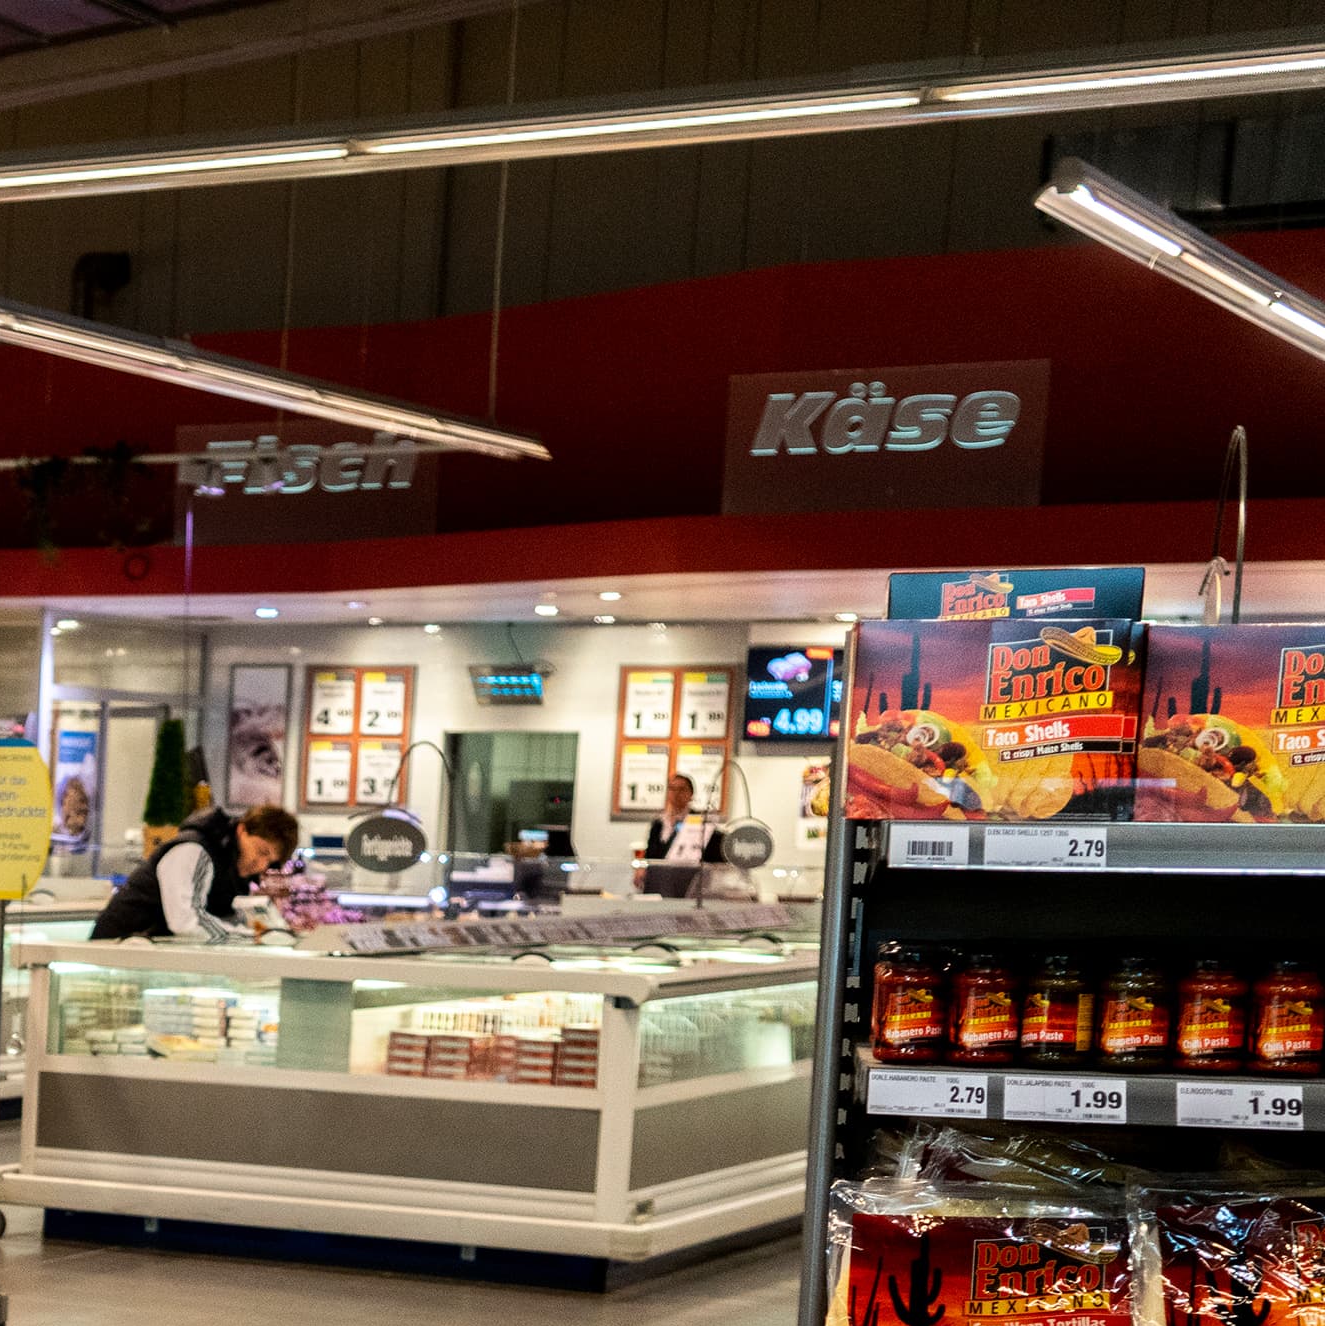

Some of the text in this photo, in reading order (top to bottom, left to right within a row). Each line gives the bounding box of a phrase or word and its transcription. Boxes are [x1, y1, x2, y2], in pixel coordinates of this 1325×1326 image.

[750, 381, 1022, 456] Käse
[204, 433, 418, 496] Fisch
[944, 583, 977, 598] Don
[944, 592, 1006, 614] Enrico
[993, 645, 1050, 671] Don
[990, 664, 1106, 703] Enrico
[984, 693, 1108, 719] MEXICANO
[773, 708, 824, 734] 4.99
[986, 721, 1070, 747] Taco Shells
[1278, 733, 1310, 750] Taco
[1003, 741, 1084, 760] 12 crispy Shells
[1069, 840, 1104, 858] 2.79
[886, 1027, 924, 1038] Habanero
[963, 1030, 1002, 1042] Habanero
[1040, 1031, 1064, 1041] Paste
[1205, 1037, 1230, 1047] Paste
[1286, 1040, 1311, 1050] Paste
[950, 1086, 985, 1104] 2.79
[1071, 1090, 1122, 1109] 1.99
[1248, 1097, 1303, 1116] 1.99
[977, 1243, 1040, 1269] Don
[975, 1260, 1100, 1300] Enrico
